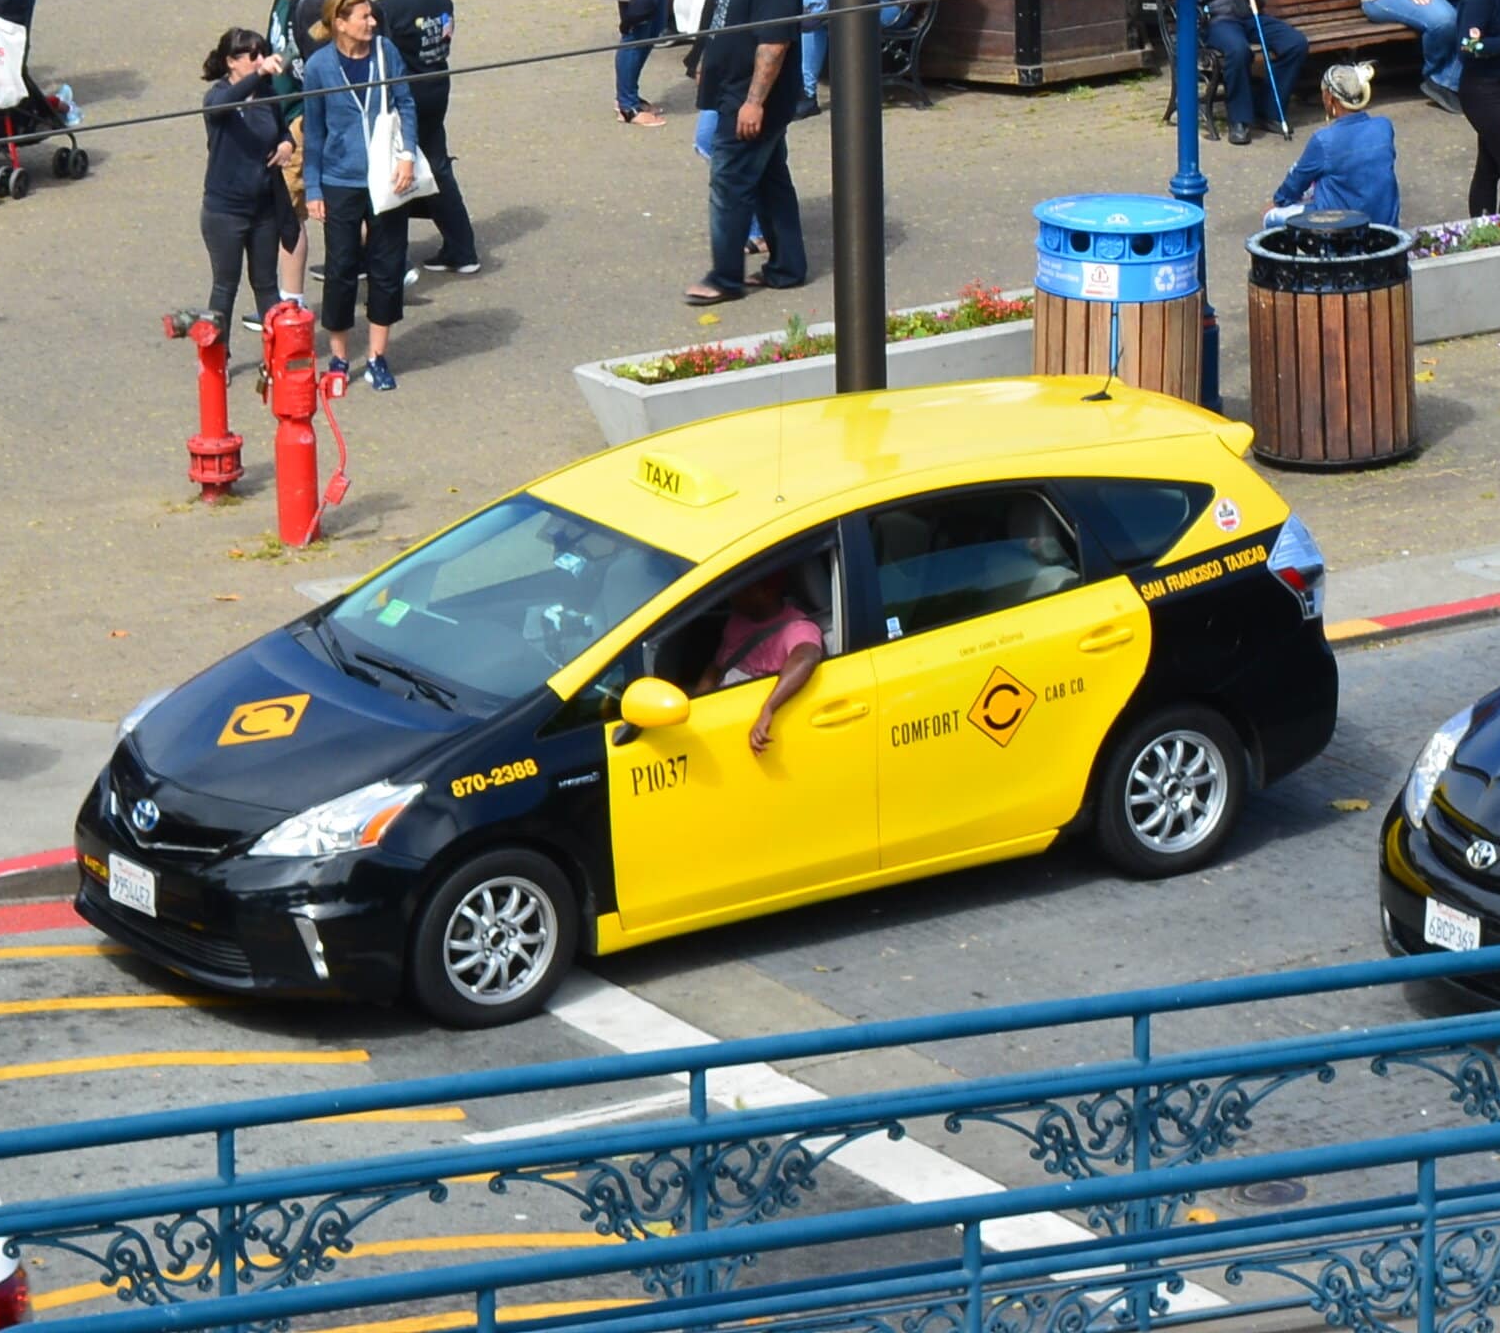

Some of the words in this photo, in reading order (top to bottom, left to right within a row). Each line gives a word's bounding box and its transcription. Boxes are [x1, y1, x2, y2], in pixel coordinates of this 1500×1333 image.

[644, 460, 681, 494] TAXI
[1140, 577, 1166, 601] SAN
[1166, 560, 1223, 595] FRANCISCO
[1223, 544, 1268, 573] TAXICAB
[890, 709, 960, 747] COMFORT
[1044, 682, 1069, 703] CAB
[1070, 676, 1087, 696] CO.
[451, 757, 539, 799] 870-2388
[630, 754, 690, 797] P1037
